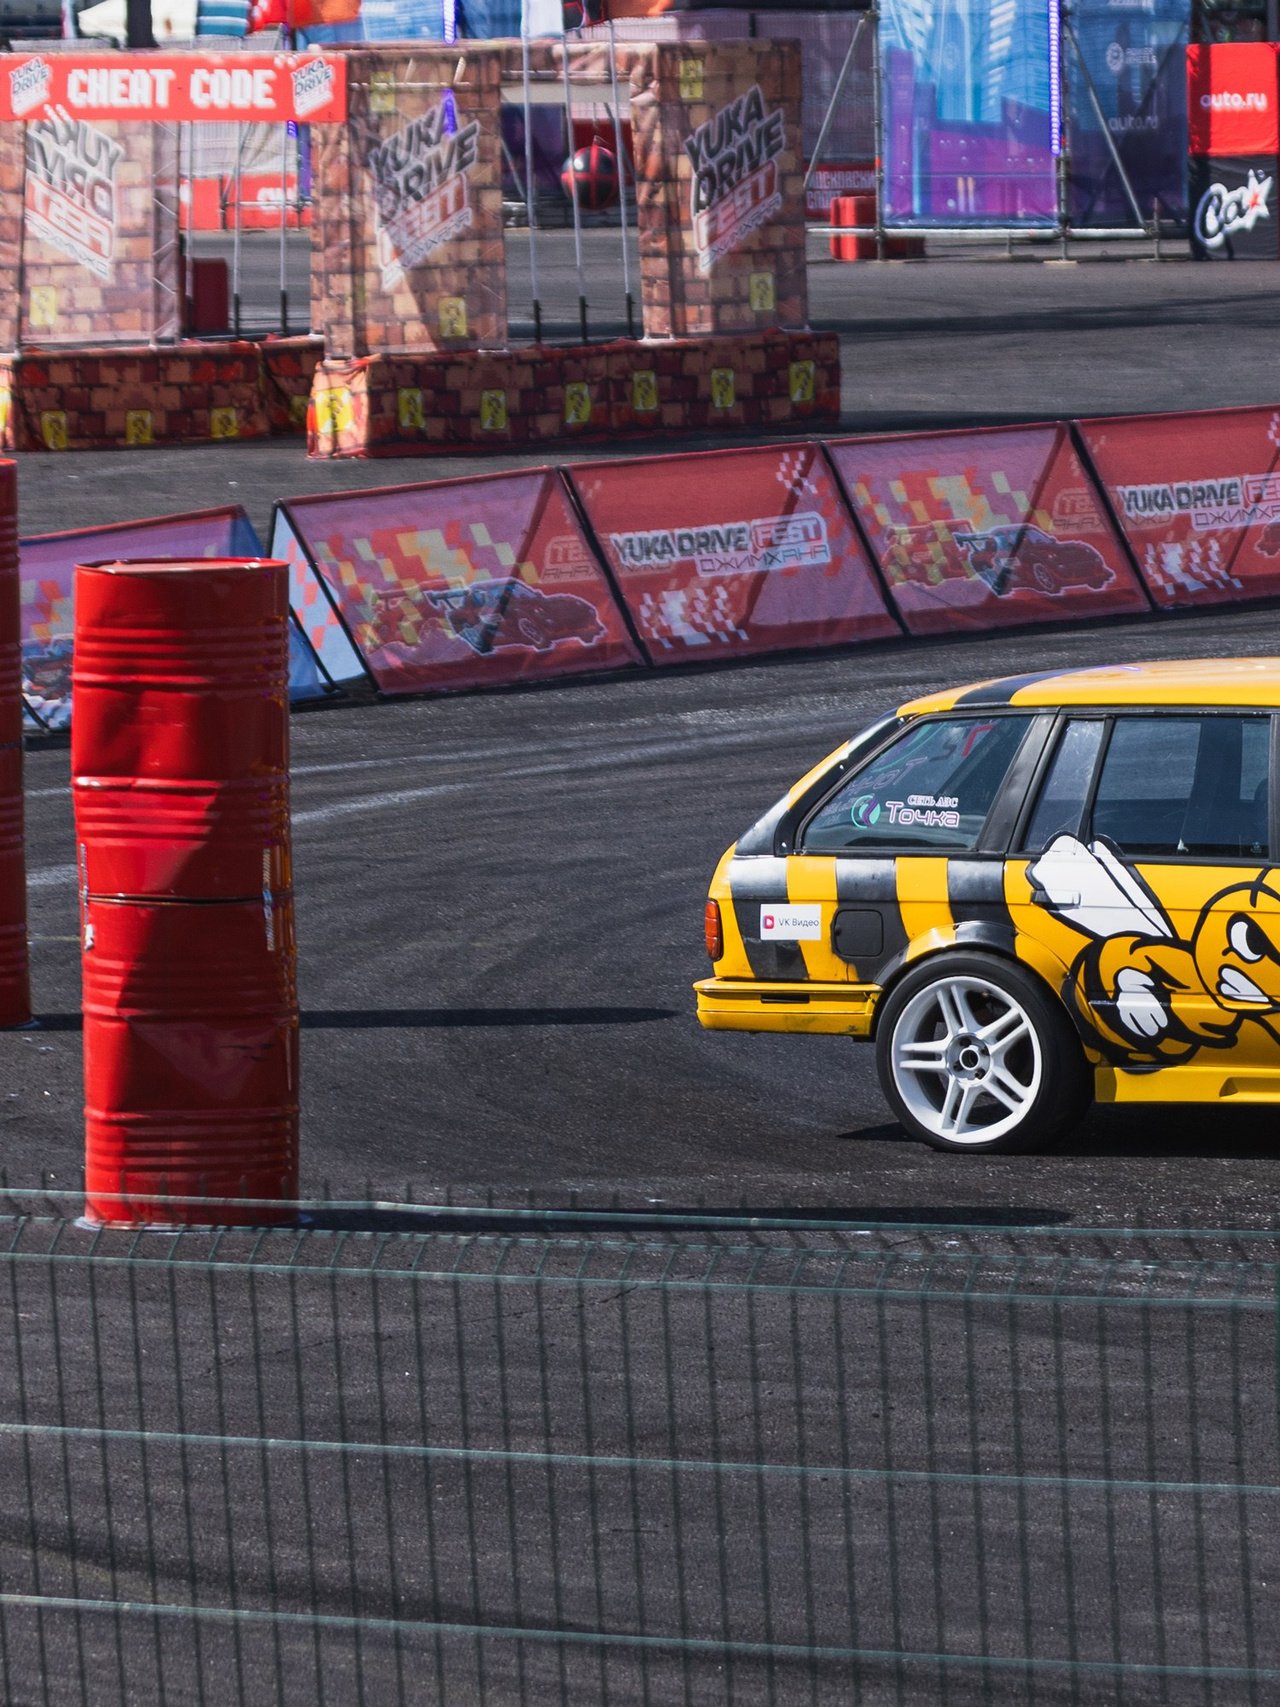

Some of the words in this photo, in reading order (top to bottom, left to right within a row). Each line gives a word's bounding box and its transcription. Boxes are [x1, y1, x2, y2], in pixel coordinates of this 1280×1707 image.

[67, 68, 175, 107] CHEAT
[189, 68, 276, 107] CODE
[1201, 91, 1267, 110] auto.ru
[685, 86, 764, 173] YUKA
[694, 110, 784, 217] DRIVE
[698, 162, 775, 250] FEST
[1121, 486, 1174, 513] YUKA
[1176, 482, 1240, 508] DRIVE
[613, 535, 674, 562] YUKA
[677, 527, 749, 556] DRIVE
[755, 518, 820, 544] FEST
[700, 547, 828, 573] ДЖИМХАНА
[886, 801, 959, 827] Точка
[778, 918, 790, 926] VK
[792, 918, 820, 927] Видео
